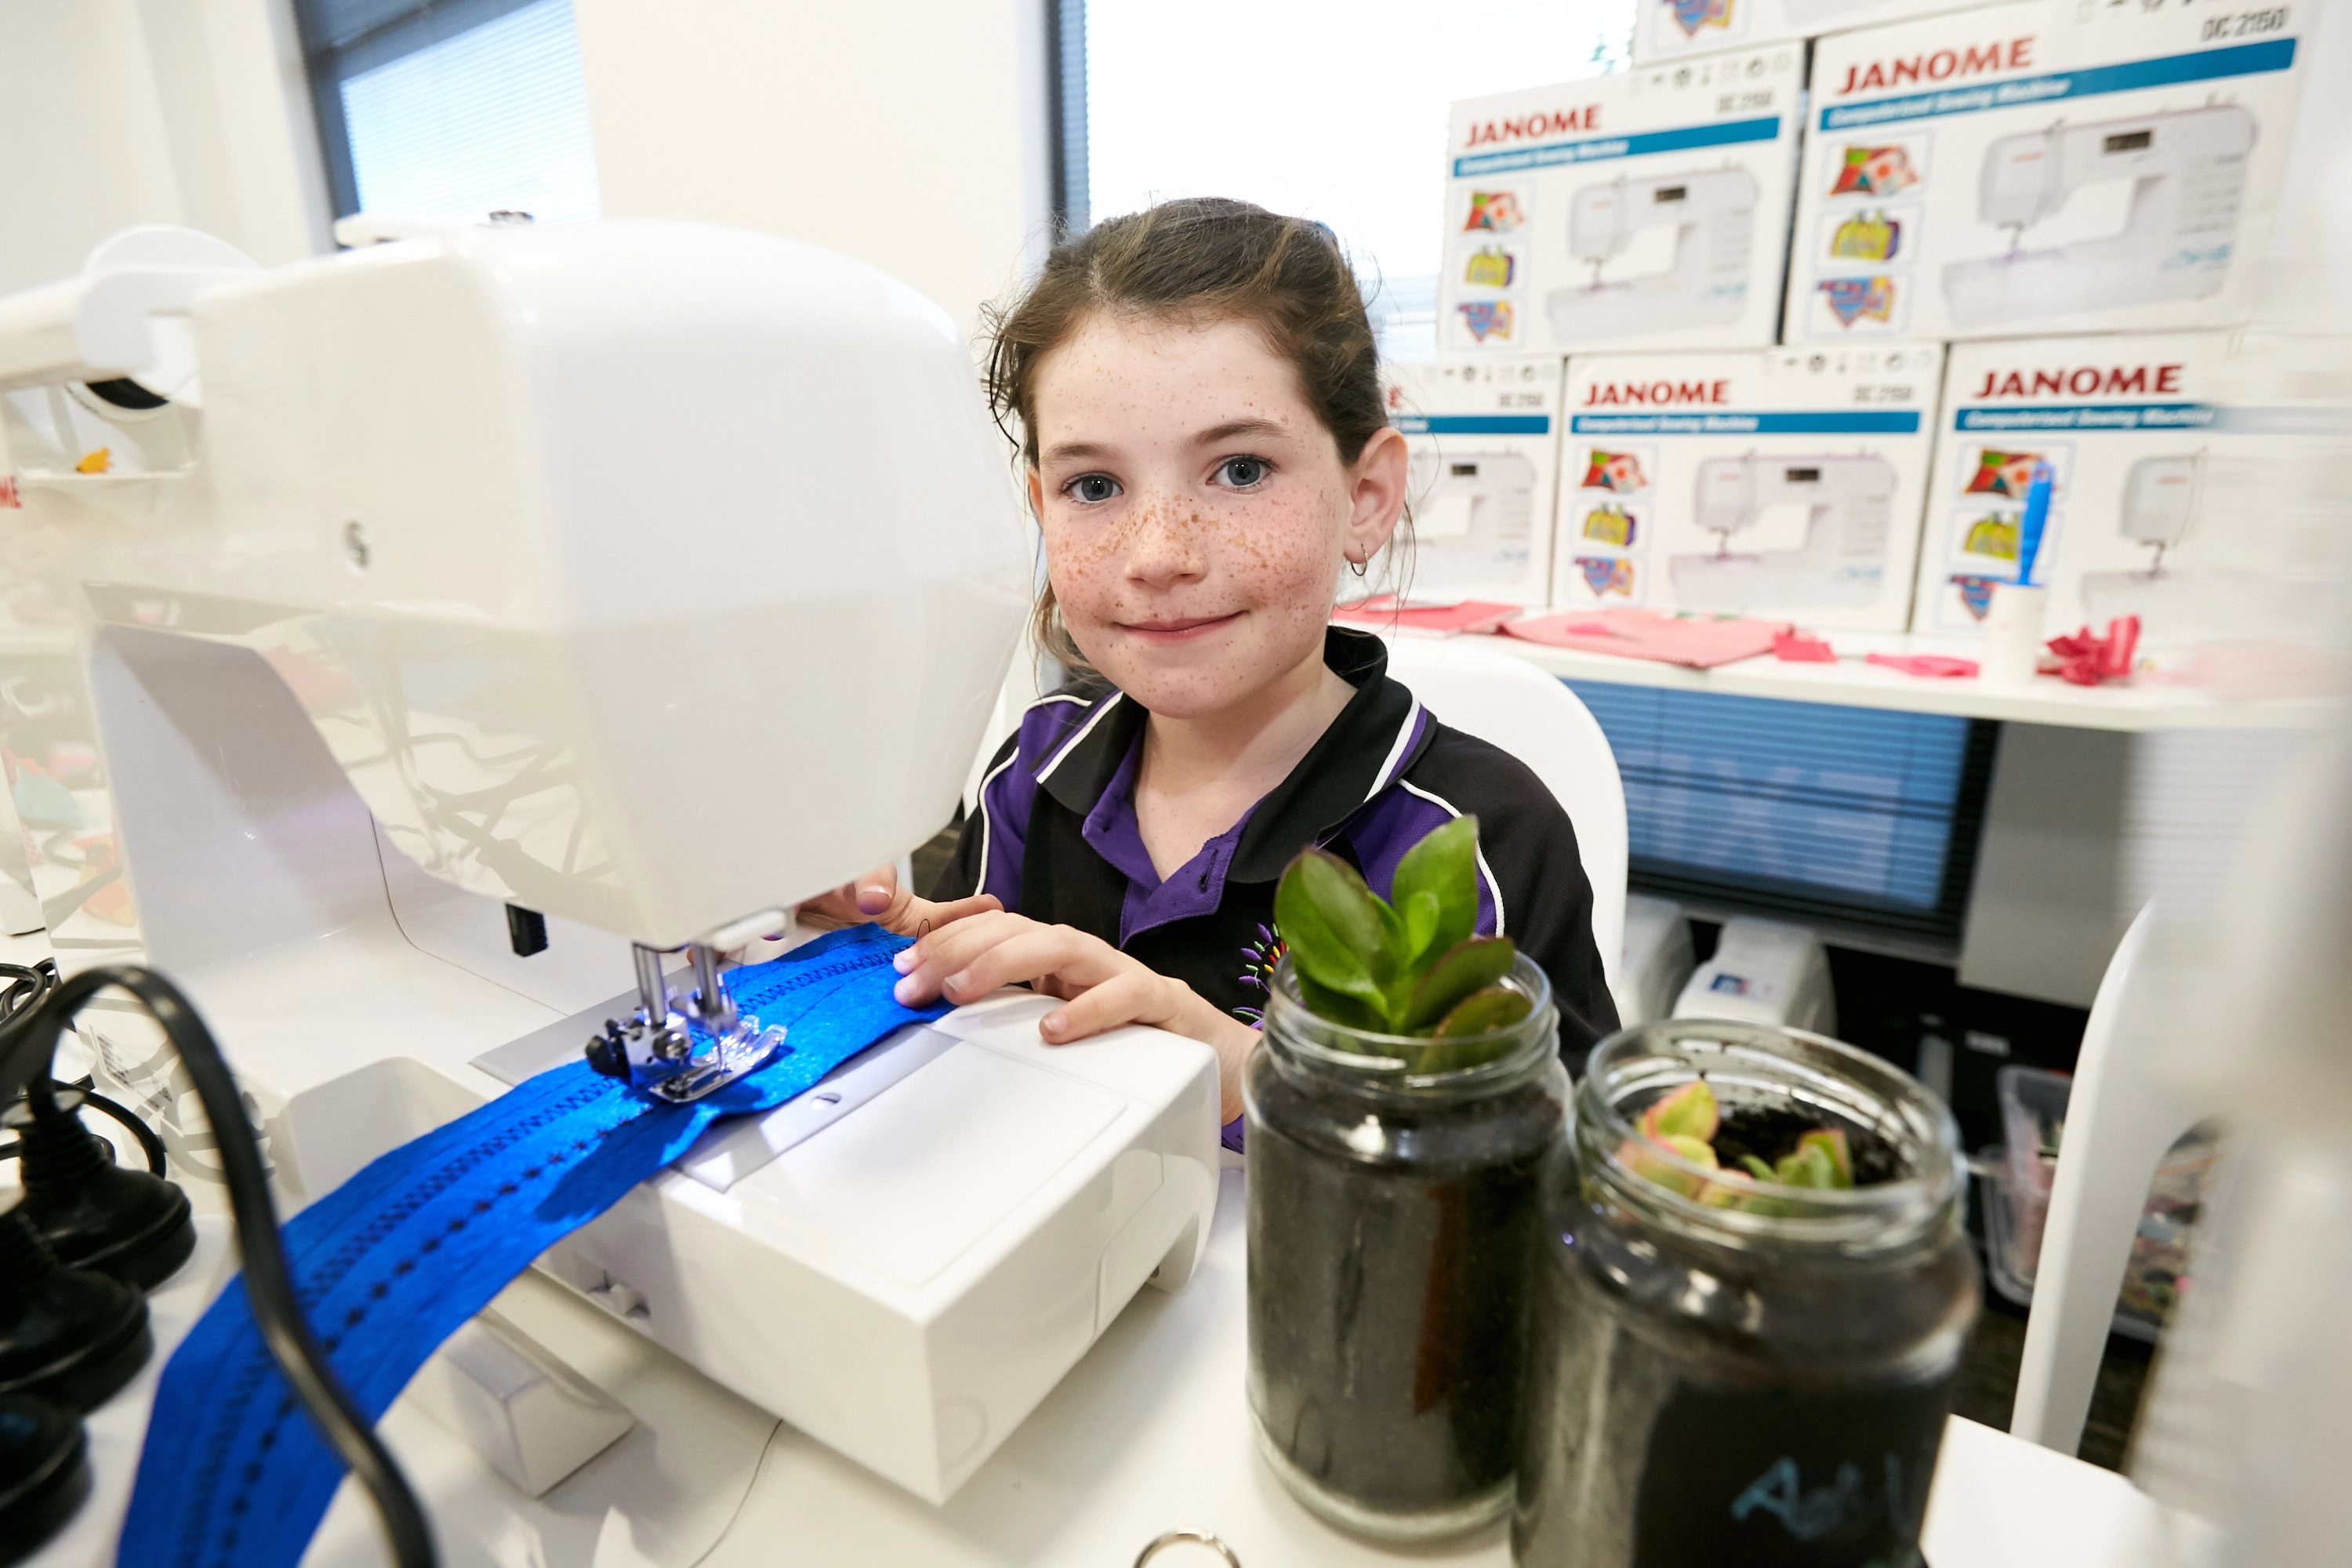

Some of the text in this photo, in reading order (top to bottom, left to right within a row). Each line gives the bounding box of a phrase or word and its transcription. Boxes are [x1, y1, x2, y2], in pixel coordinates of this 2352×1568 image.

[2201, 8, 2288, 42] DC 2150
[1837, 36, 2034, 95] JANOME
[1466, 103, 1601, 148] JANOME
[1583, 379, 1731, 406] JANOME
[1973, 364, 2183, 398] JANOME
